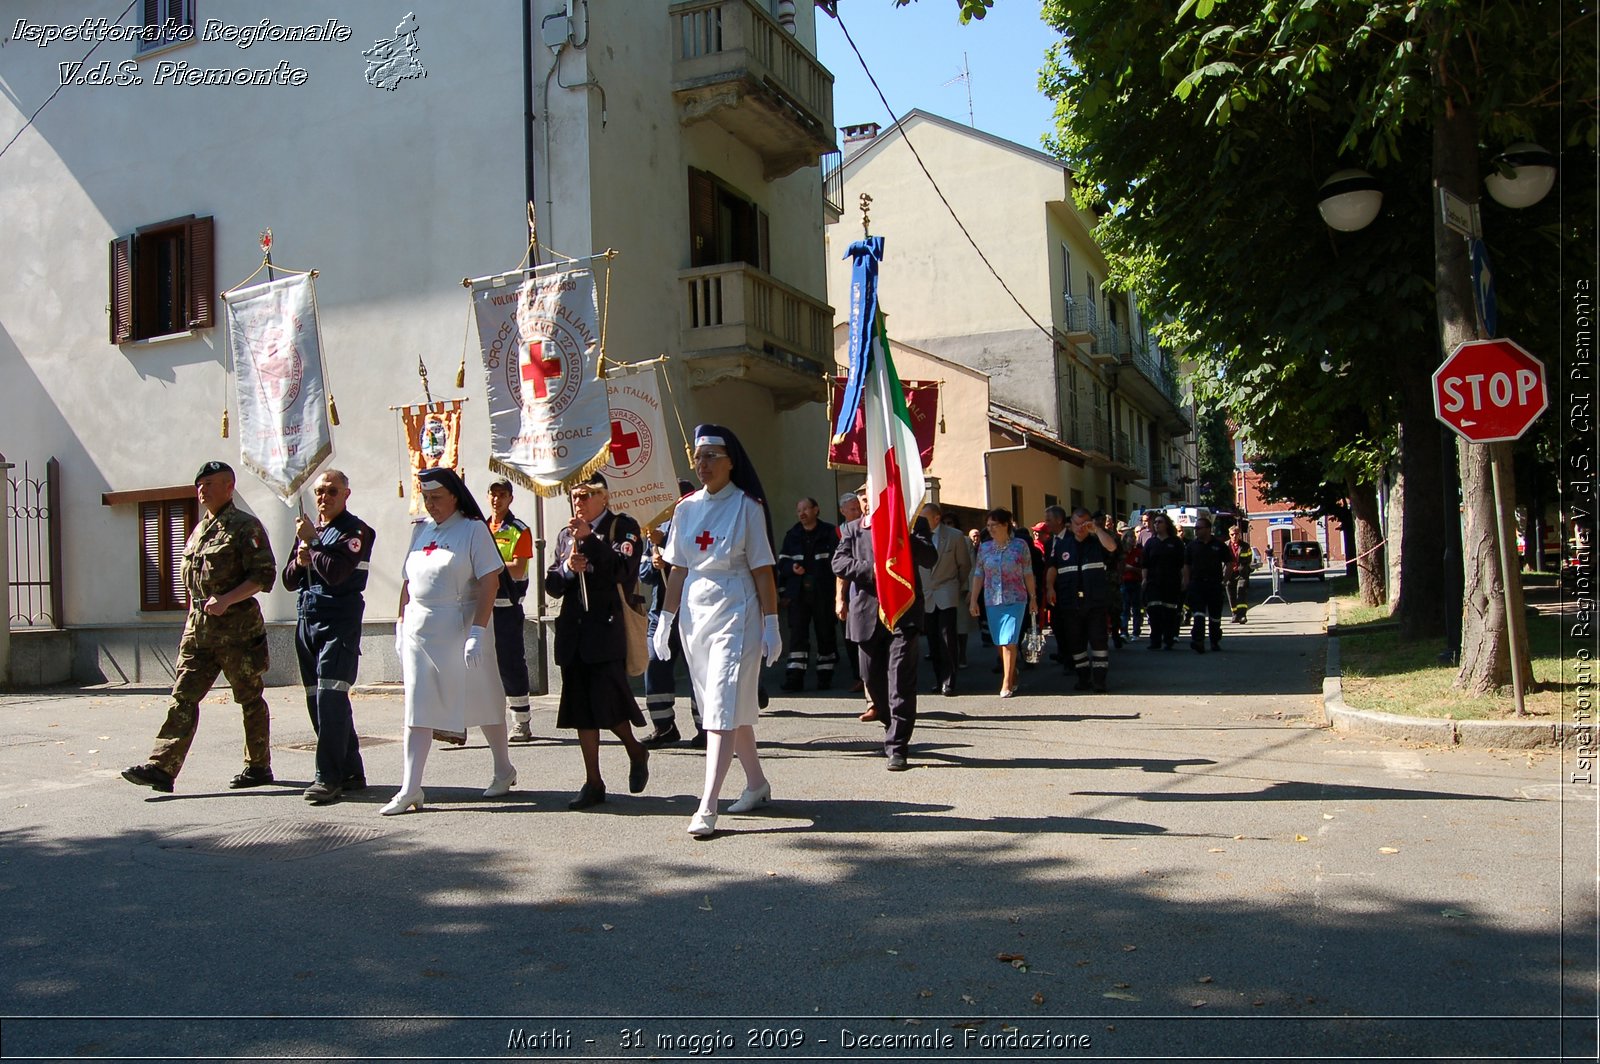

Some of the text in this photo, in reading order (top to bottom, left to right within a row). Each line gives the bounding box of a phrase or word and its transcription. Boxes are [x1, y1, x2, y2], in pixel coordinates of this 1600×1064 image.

[488, 321, 513, 369] CROCE
[562, 336, 574, 351] 22
[567, 351, 580, 393] AGOSTO
[623, 386, 659, 411] ITALIANA
[1443, 369, 1537, 412] STOP
[551, 426, 593, 442] LOCALE
[610, 410, 628, 421] EVRA
[628, 414, 637, 424] 22
[636, 420, 651, 449] AGOSTO
[610, 481, 665, 498] ITATO LOCALE
[609, 493, 674, 513] TIMO TORINESE
